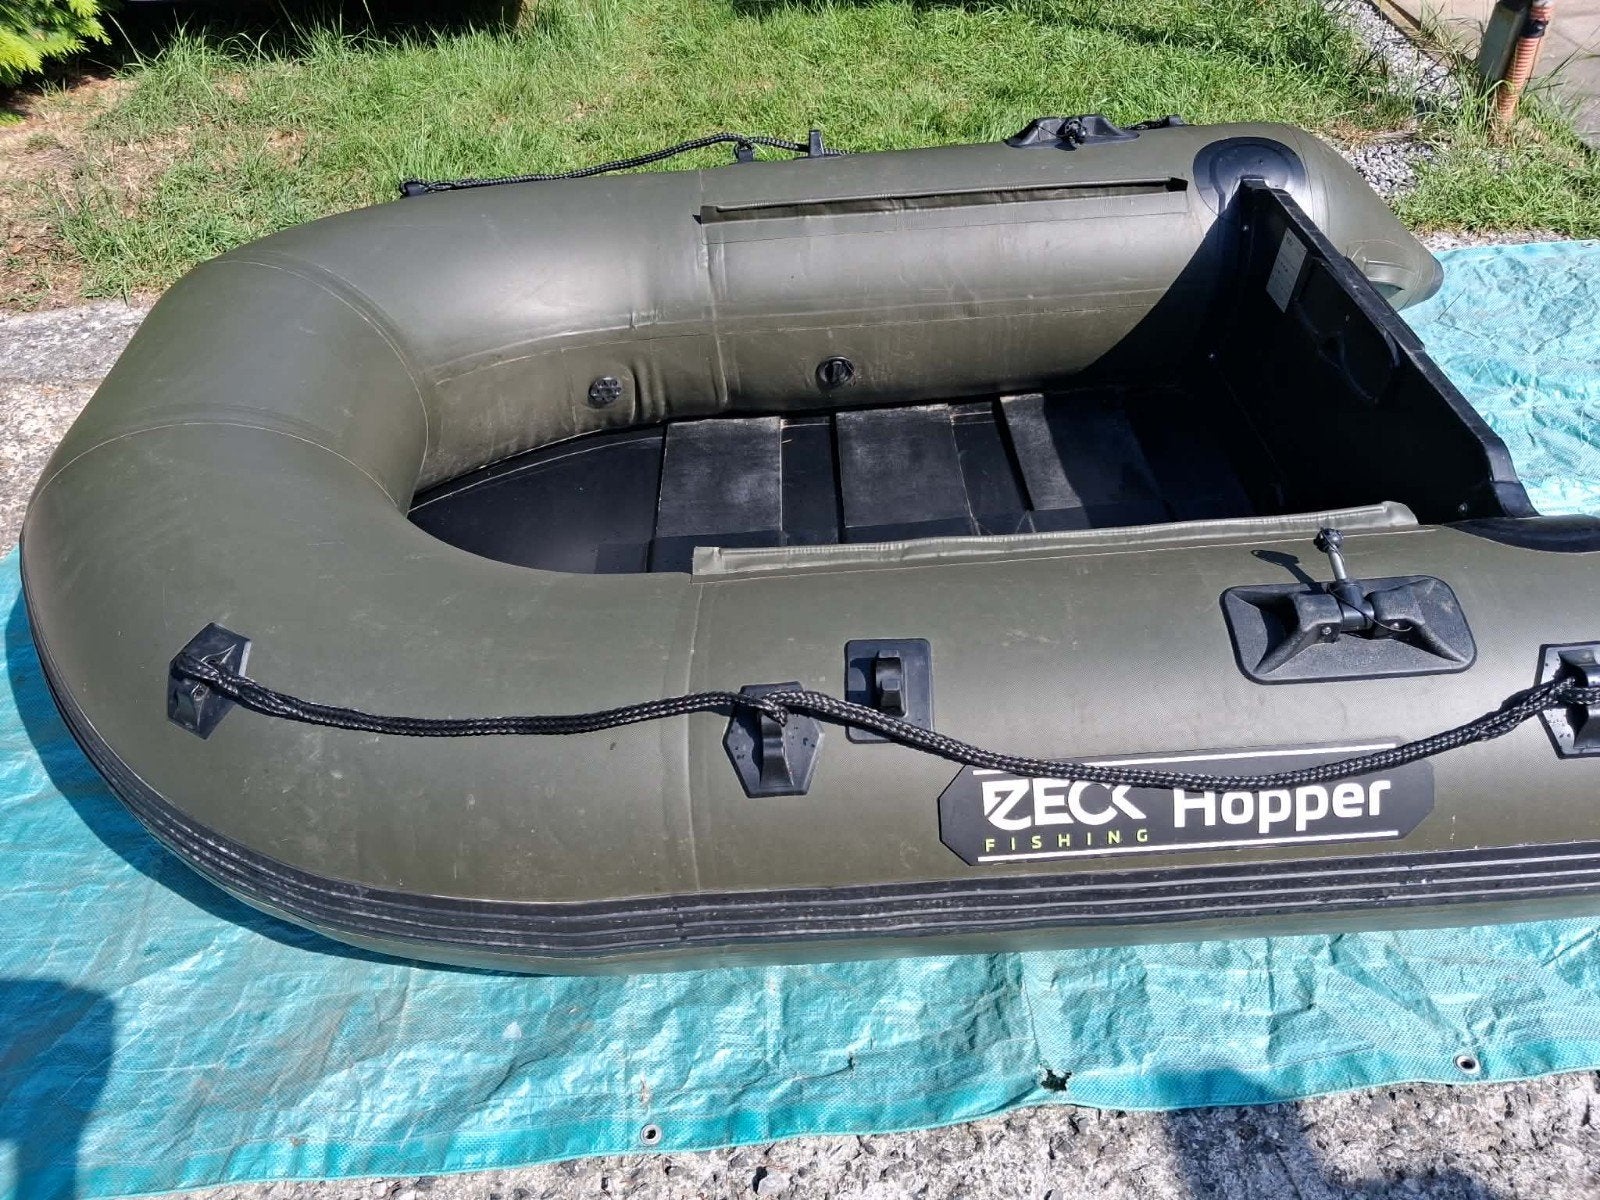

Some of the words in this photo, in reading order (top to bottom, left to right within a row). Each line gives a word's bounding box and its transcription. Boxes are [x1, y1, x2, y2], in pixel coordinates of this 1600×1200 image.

[982, 778, 1146, 830] ZECK
[1173, 779, 1391, 834] Hopper
[985, 829, 1148, 852] FISHING
